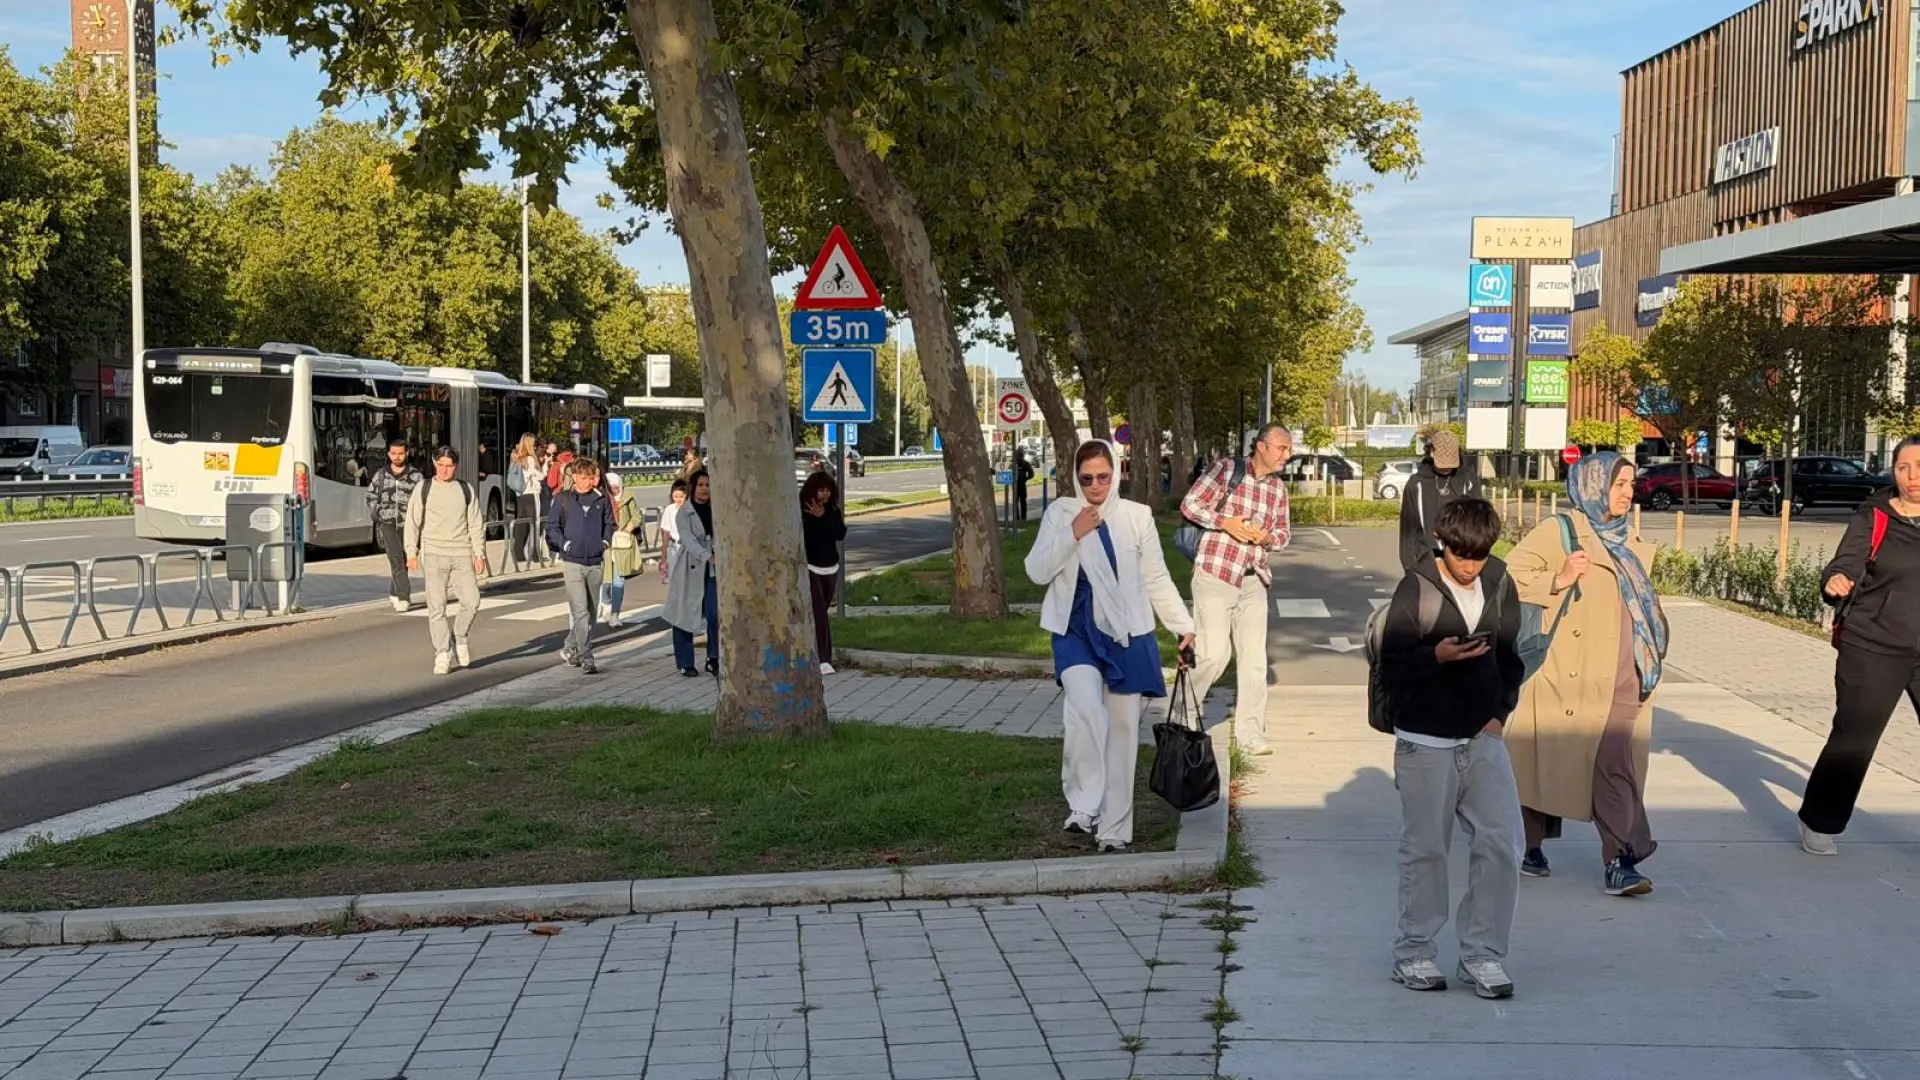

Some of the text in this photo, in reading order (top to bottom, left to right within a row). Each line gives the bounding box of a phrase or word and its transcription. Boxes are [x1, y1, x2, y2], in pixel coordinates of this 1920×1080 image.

[1724, 129, 1773, 181] ACTION
[1537, 281, 1569, 290] ACTION
[806, 315, 870, 341] 35m
[1473, 325, 1508, 335] Dream
[1478, 333, 1504, 343] Land
[1537, 329, 1567, 340] JYSK
[1001, 381, 1025, 390] ZONE
[1005, 401, 1023, 414] 50
